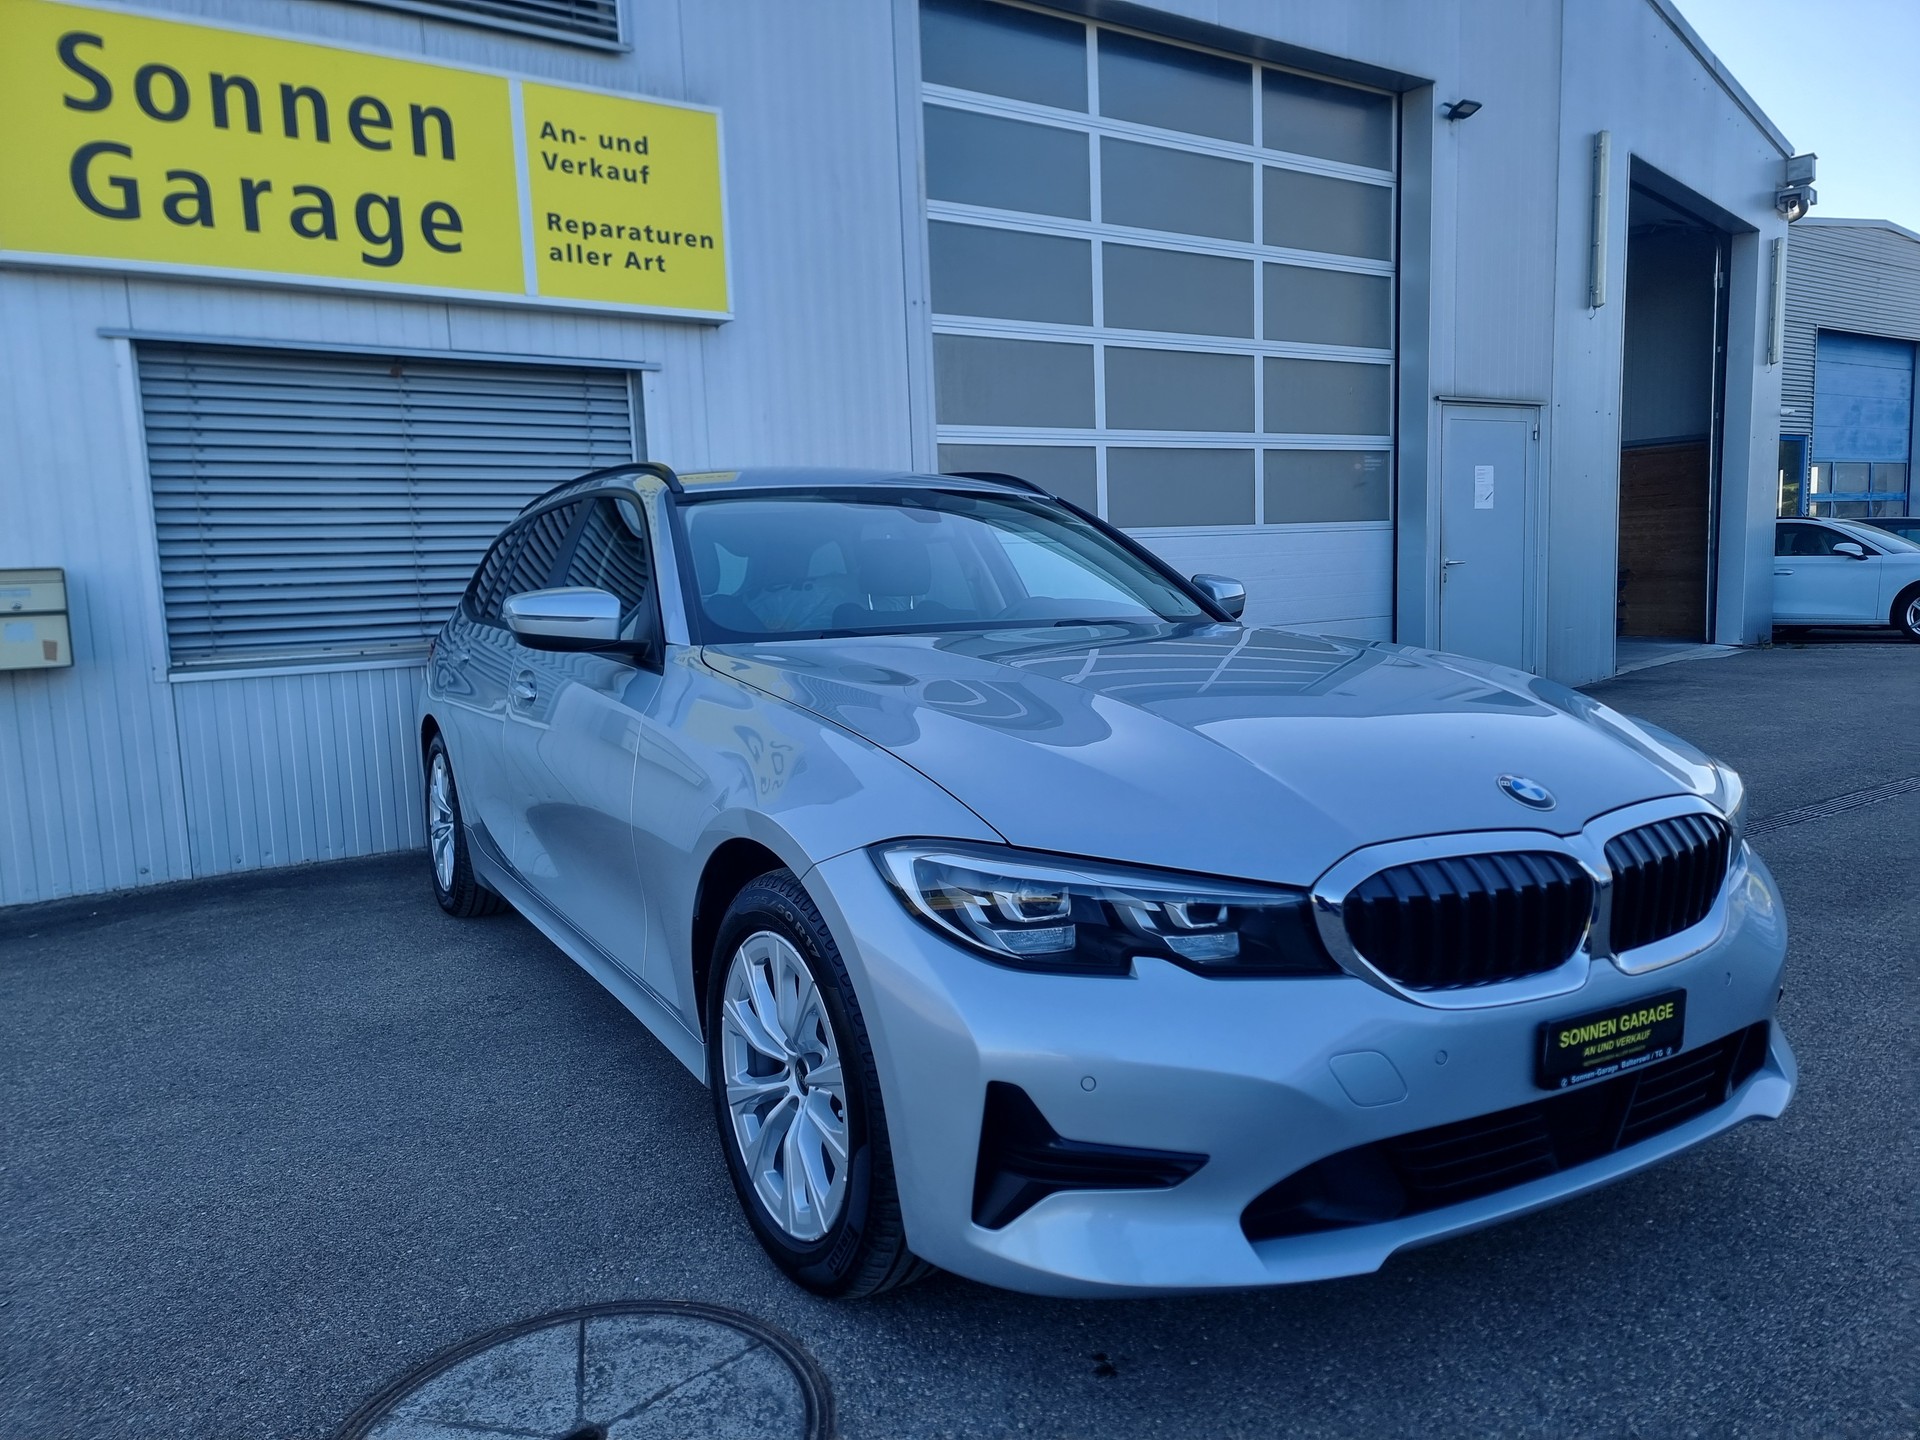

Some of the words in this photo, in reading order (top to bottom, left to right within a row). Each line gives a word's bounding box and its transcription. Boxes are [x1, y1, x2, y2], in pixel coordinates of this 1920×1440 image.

[56, 30, 456, 162] Sonnen
[539, 120, 587, 145] An-
[598, 134, 649, 156] und
[541, 150, 650, 185] Verkauf
[69, 139, 464, 268] Garage
[546, 211, 714, 250] Reparaturen
[549, 242, 613, 267] aller
[624, 250, 667, 273] Art
[745, 895, 794, 923] 225/50
[1559, 1018, 1617, 1048] SONNEN
[1619, 1002, 1674, 1031] GARAGE
[1583, 1045, 1597, 1057] AN
[1597, 1040, 1615, 1053] UND
[1616, 1028, 1652, 1048] VERKAUF
[1655, 1049, 1664, 1059] TG
